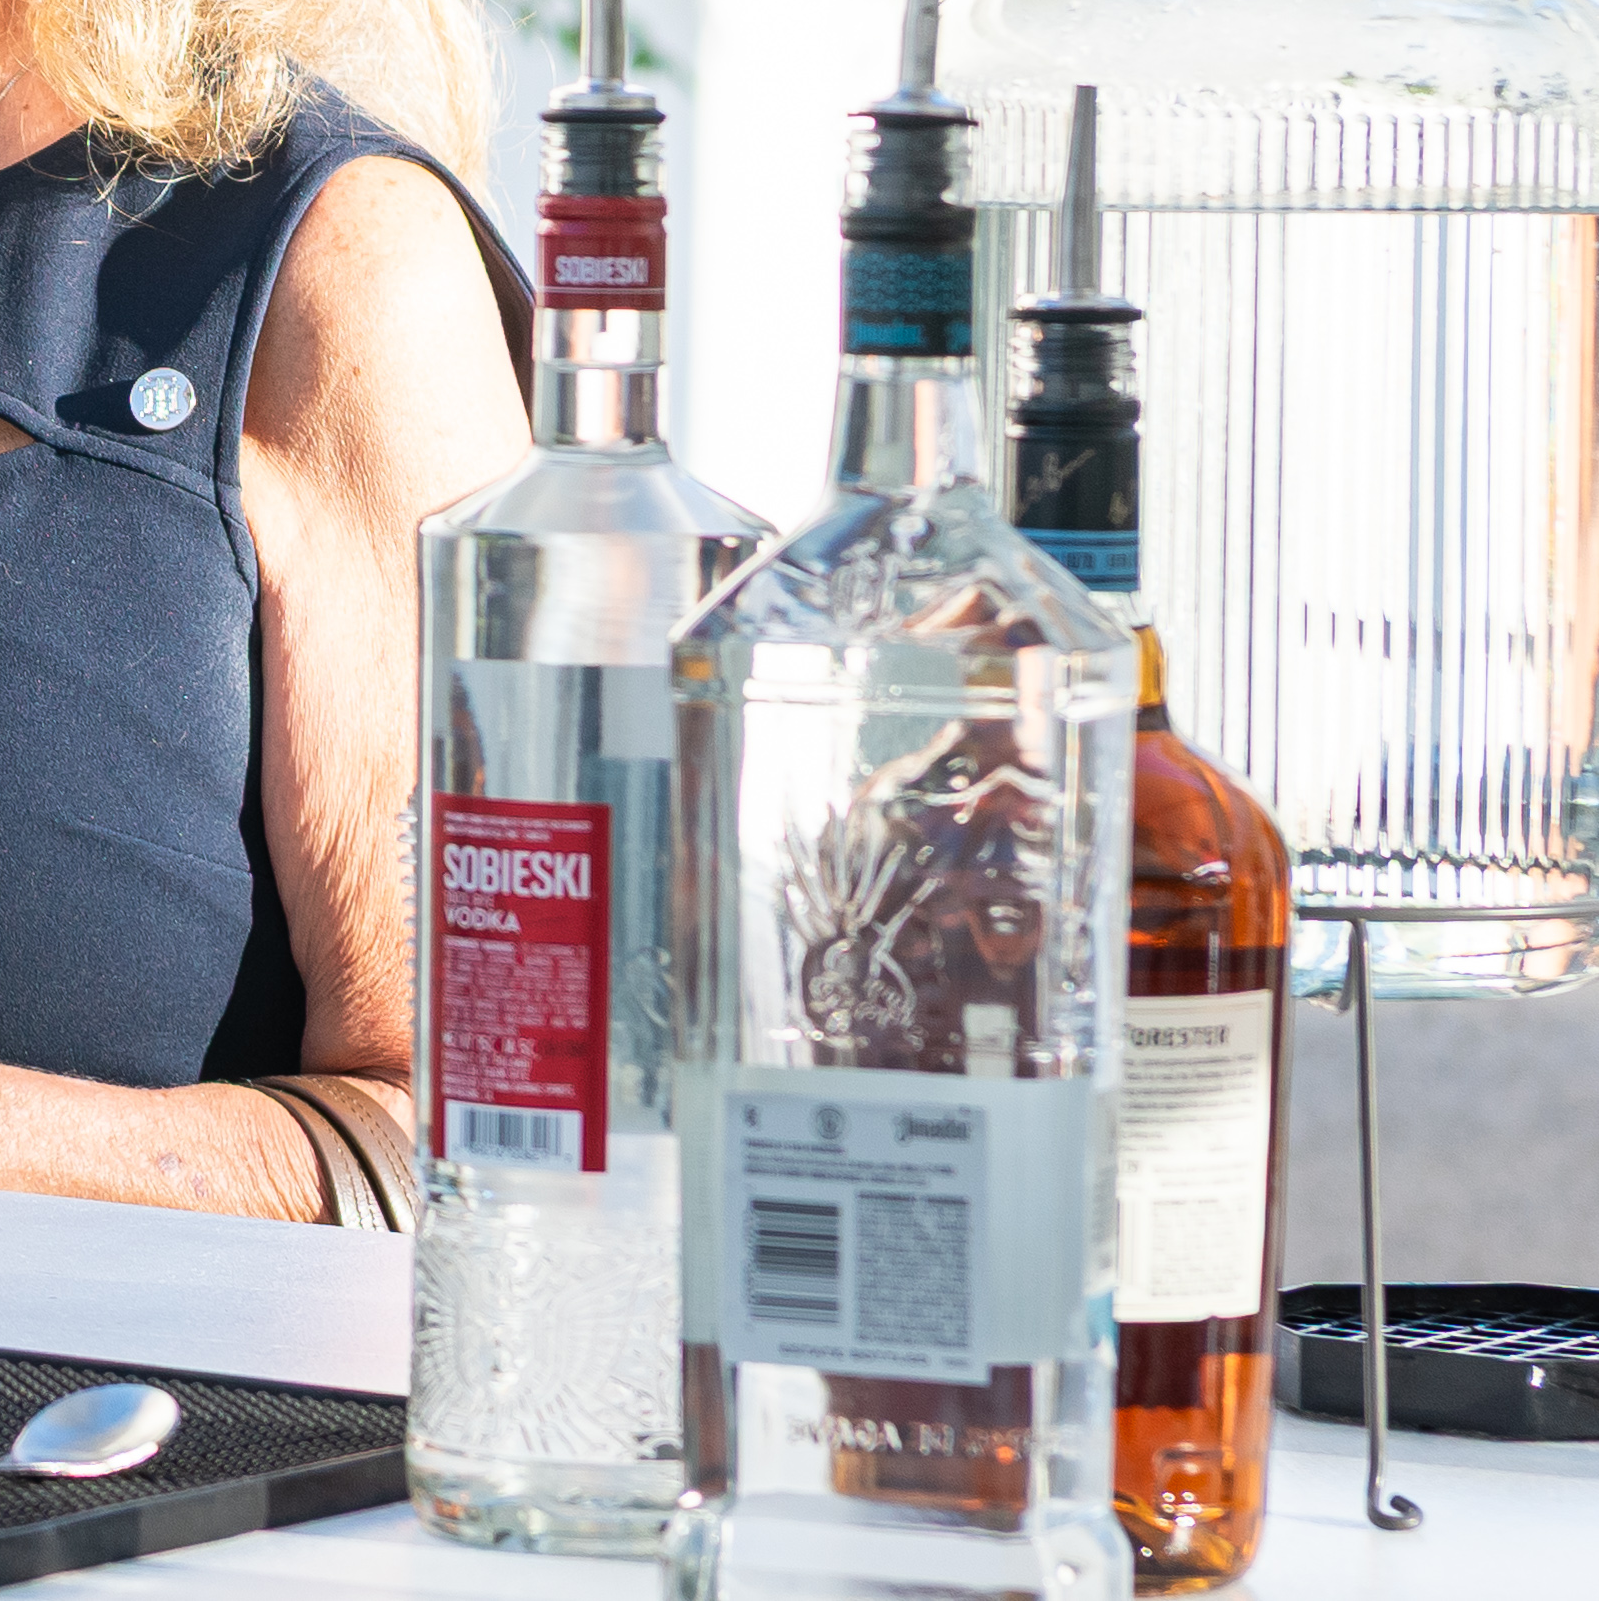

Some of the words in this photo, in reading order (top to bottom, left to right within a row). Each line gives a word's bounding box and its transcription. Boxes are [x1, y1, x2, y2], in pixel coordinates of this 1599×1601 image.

[555, 256, 648, 285] SOBIESKI
[443, 843, 592, 899] SOBIESKI
[444, 906, 521, 933] VODKA
